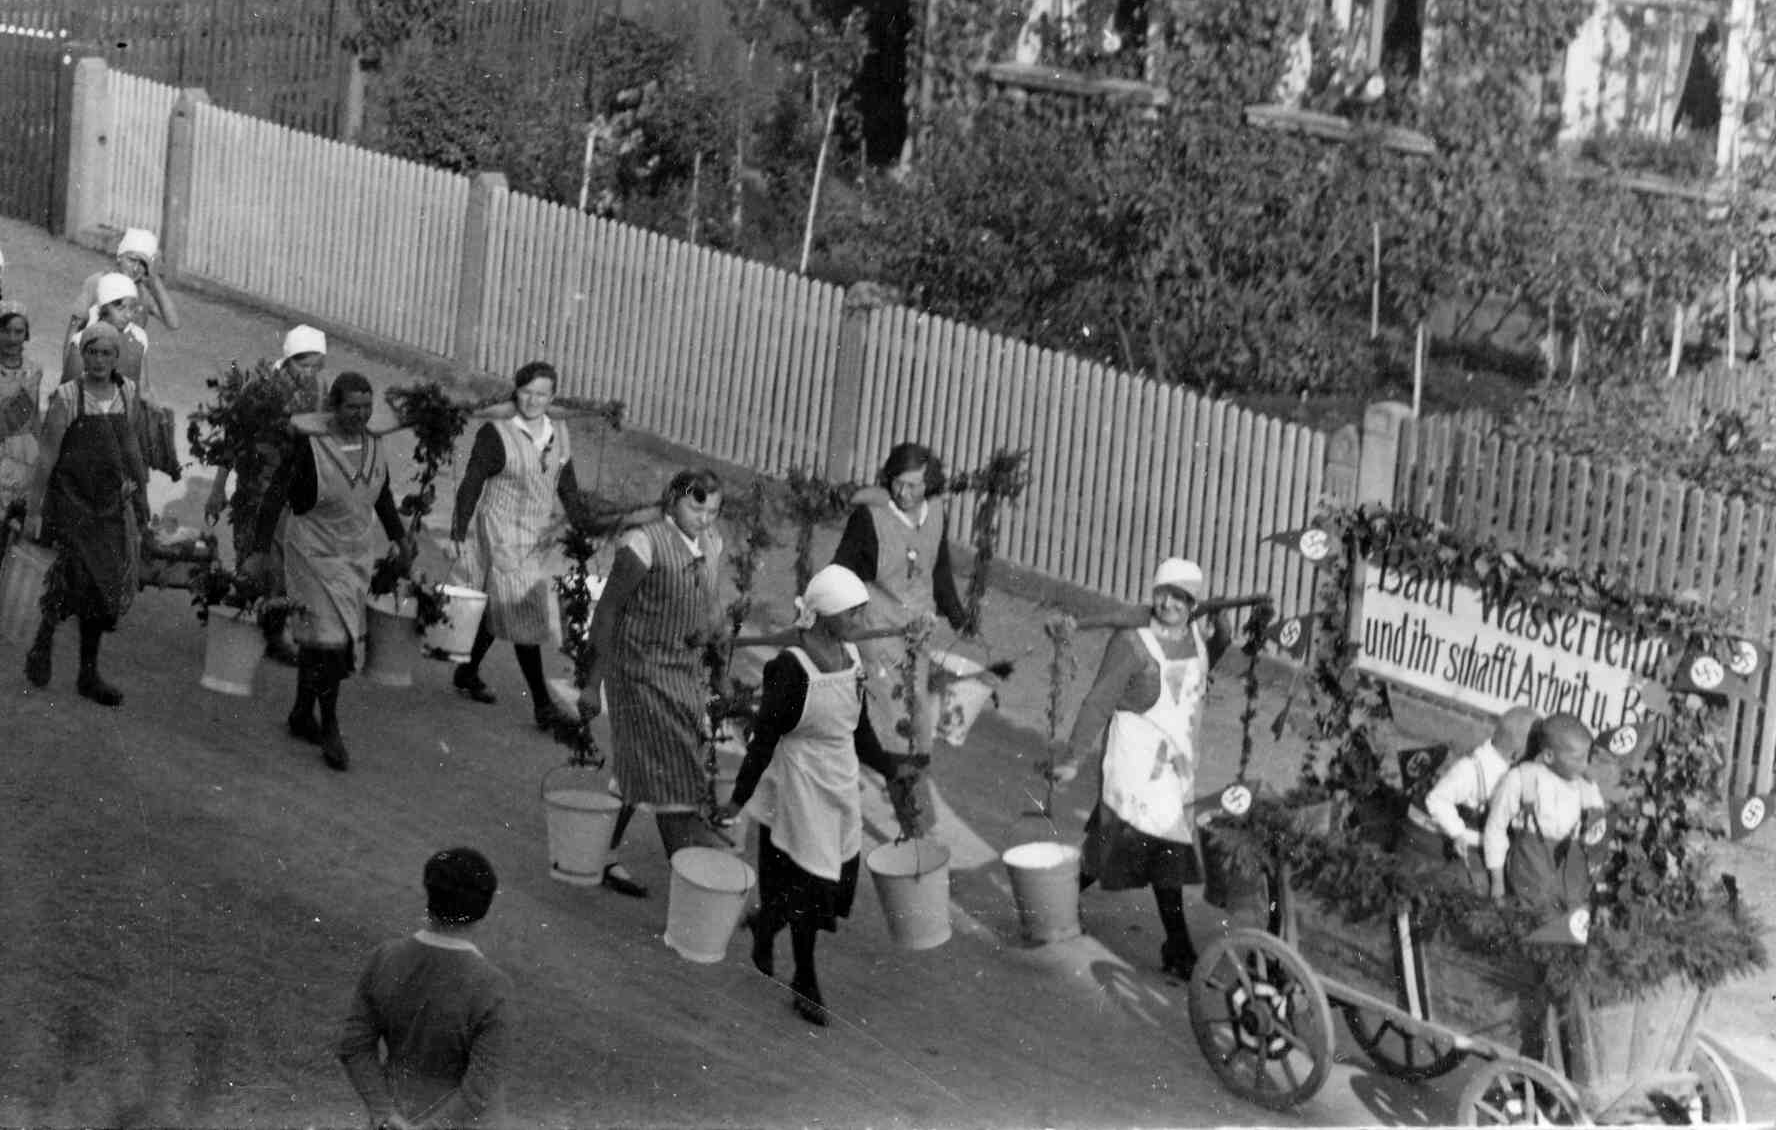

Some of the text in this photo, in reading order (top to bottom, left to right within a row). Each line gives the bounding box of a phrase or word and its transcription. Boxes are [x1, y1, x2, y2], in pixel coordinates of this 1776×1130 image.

[1364, 612, 1409, 666] und
[1407, 617, 1446, 675] ihr
[1442, 634, 1518, 700] schafft
[1512, 653, 1591, 720] Arbeit
[1620, 685, 1670, 743] Bro
[1478, 564, 1672, 683] Wasserleitu
